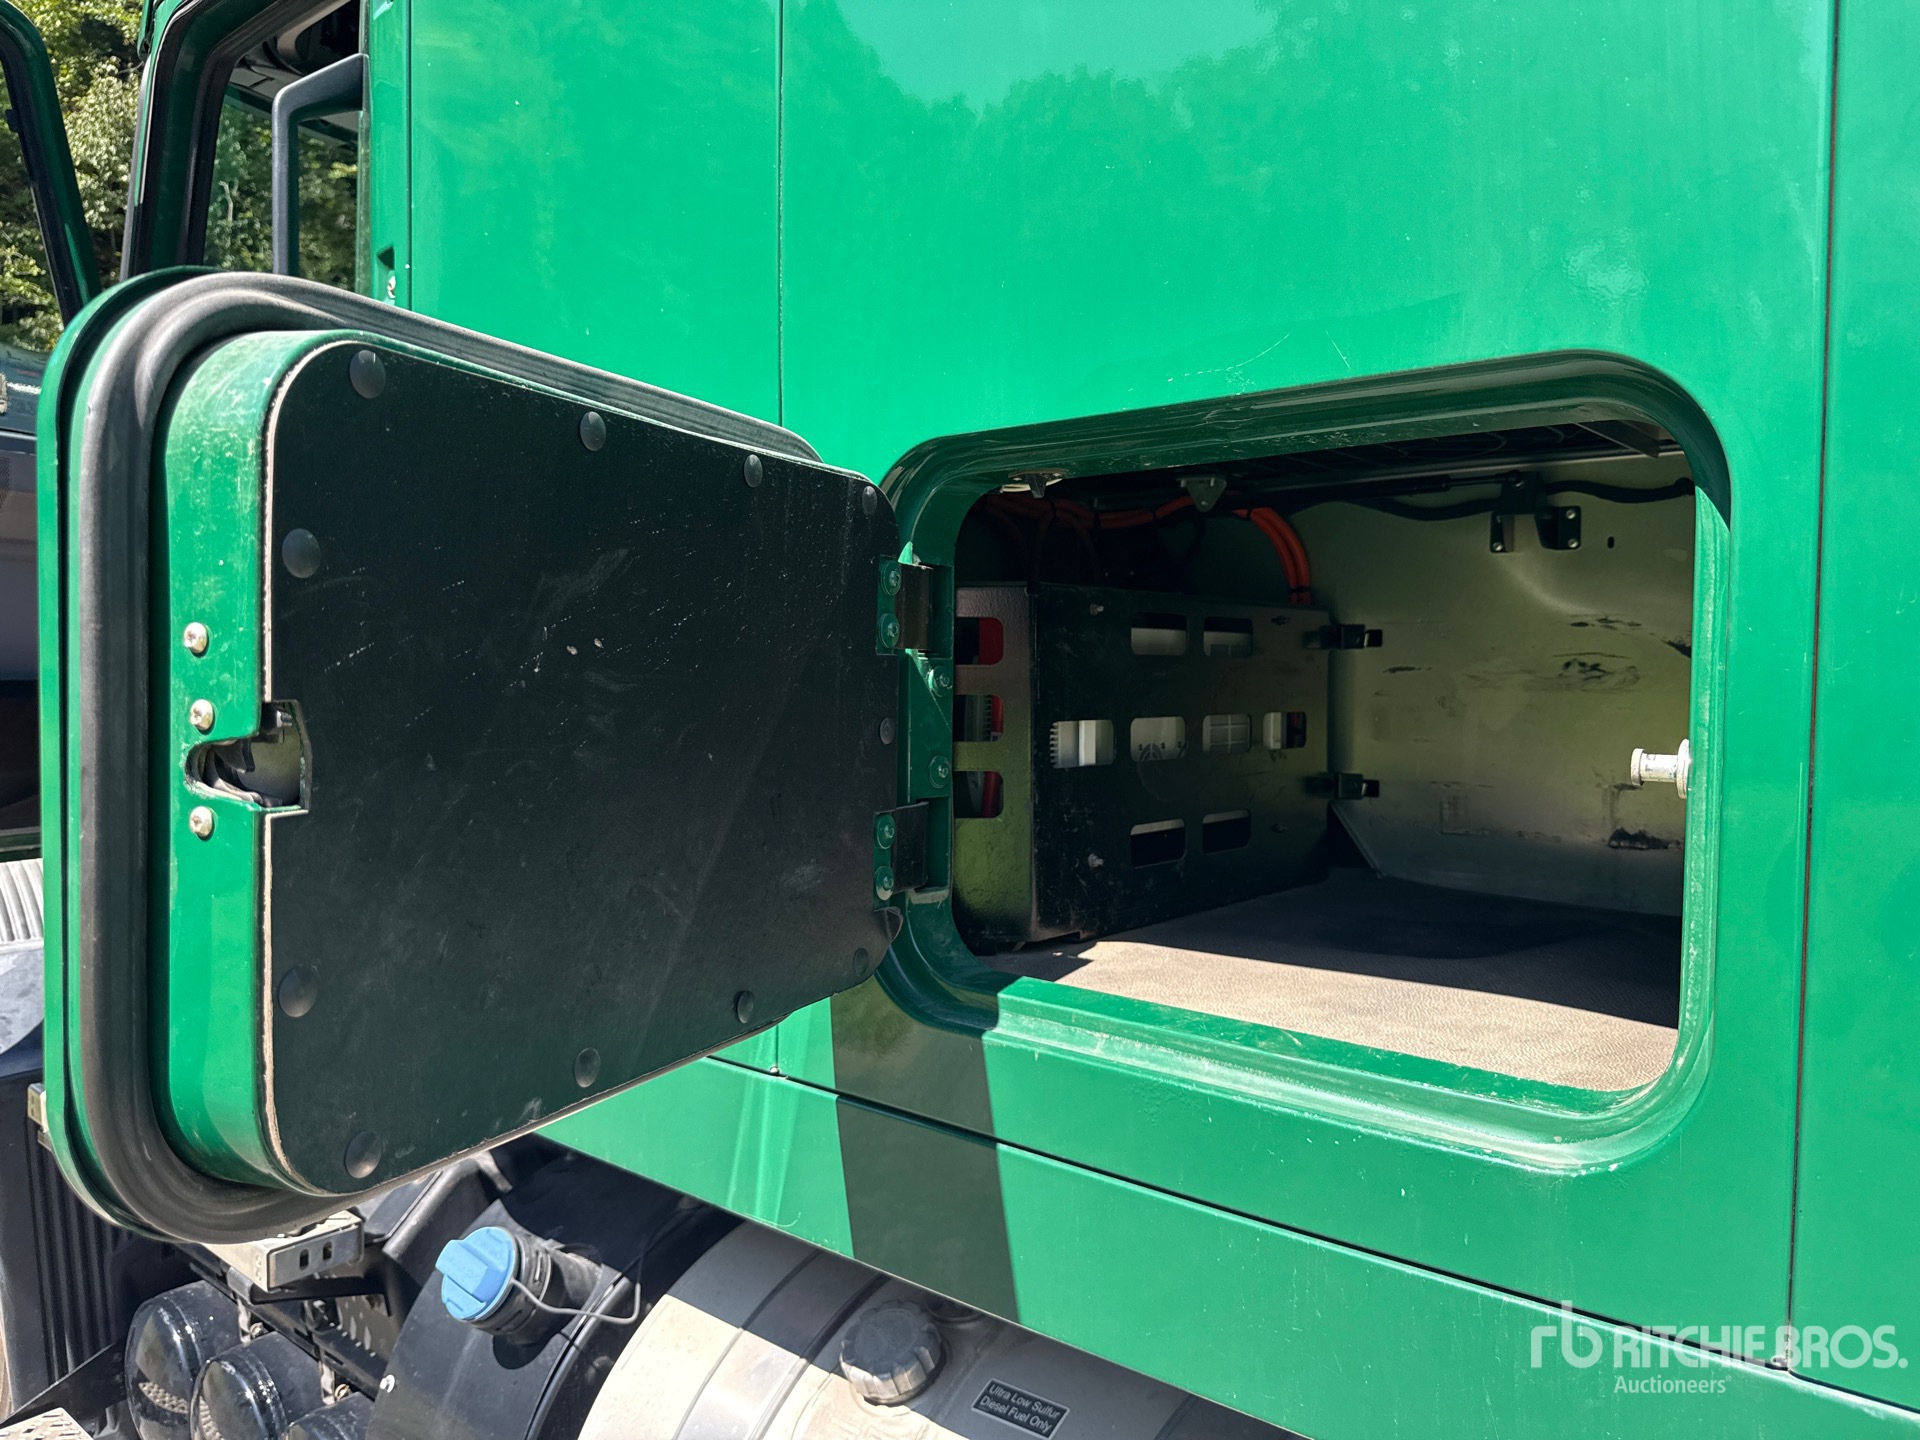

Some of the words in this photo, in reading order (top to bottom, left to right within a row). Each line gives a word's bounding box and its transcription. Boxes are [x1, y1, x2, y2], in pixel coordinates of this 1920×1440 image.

[980, 1395, 1010, 1414] Diesel
[1007, 1407, 1030, 1421] Fuel
[1029, 1415, 1052, 1433] Only
[989, 1384, 1011, 1399] Ultra
[1011, 1392, 1031, 1407] Low
[1032, 1401, 1060, 1418] Sulfur
